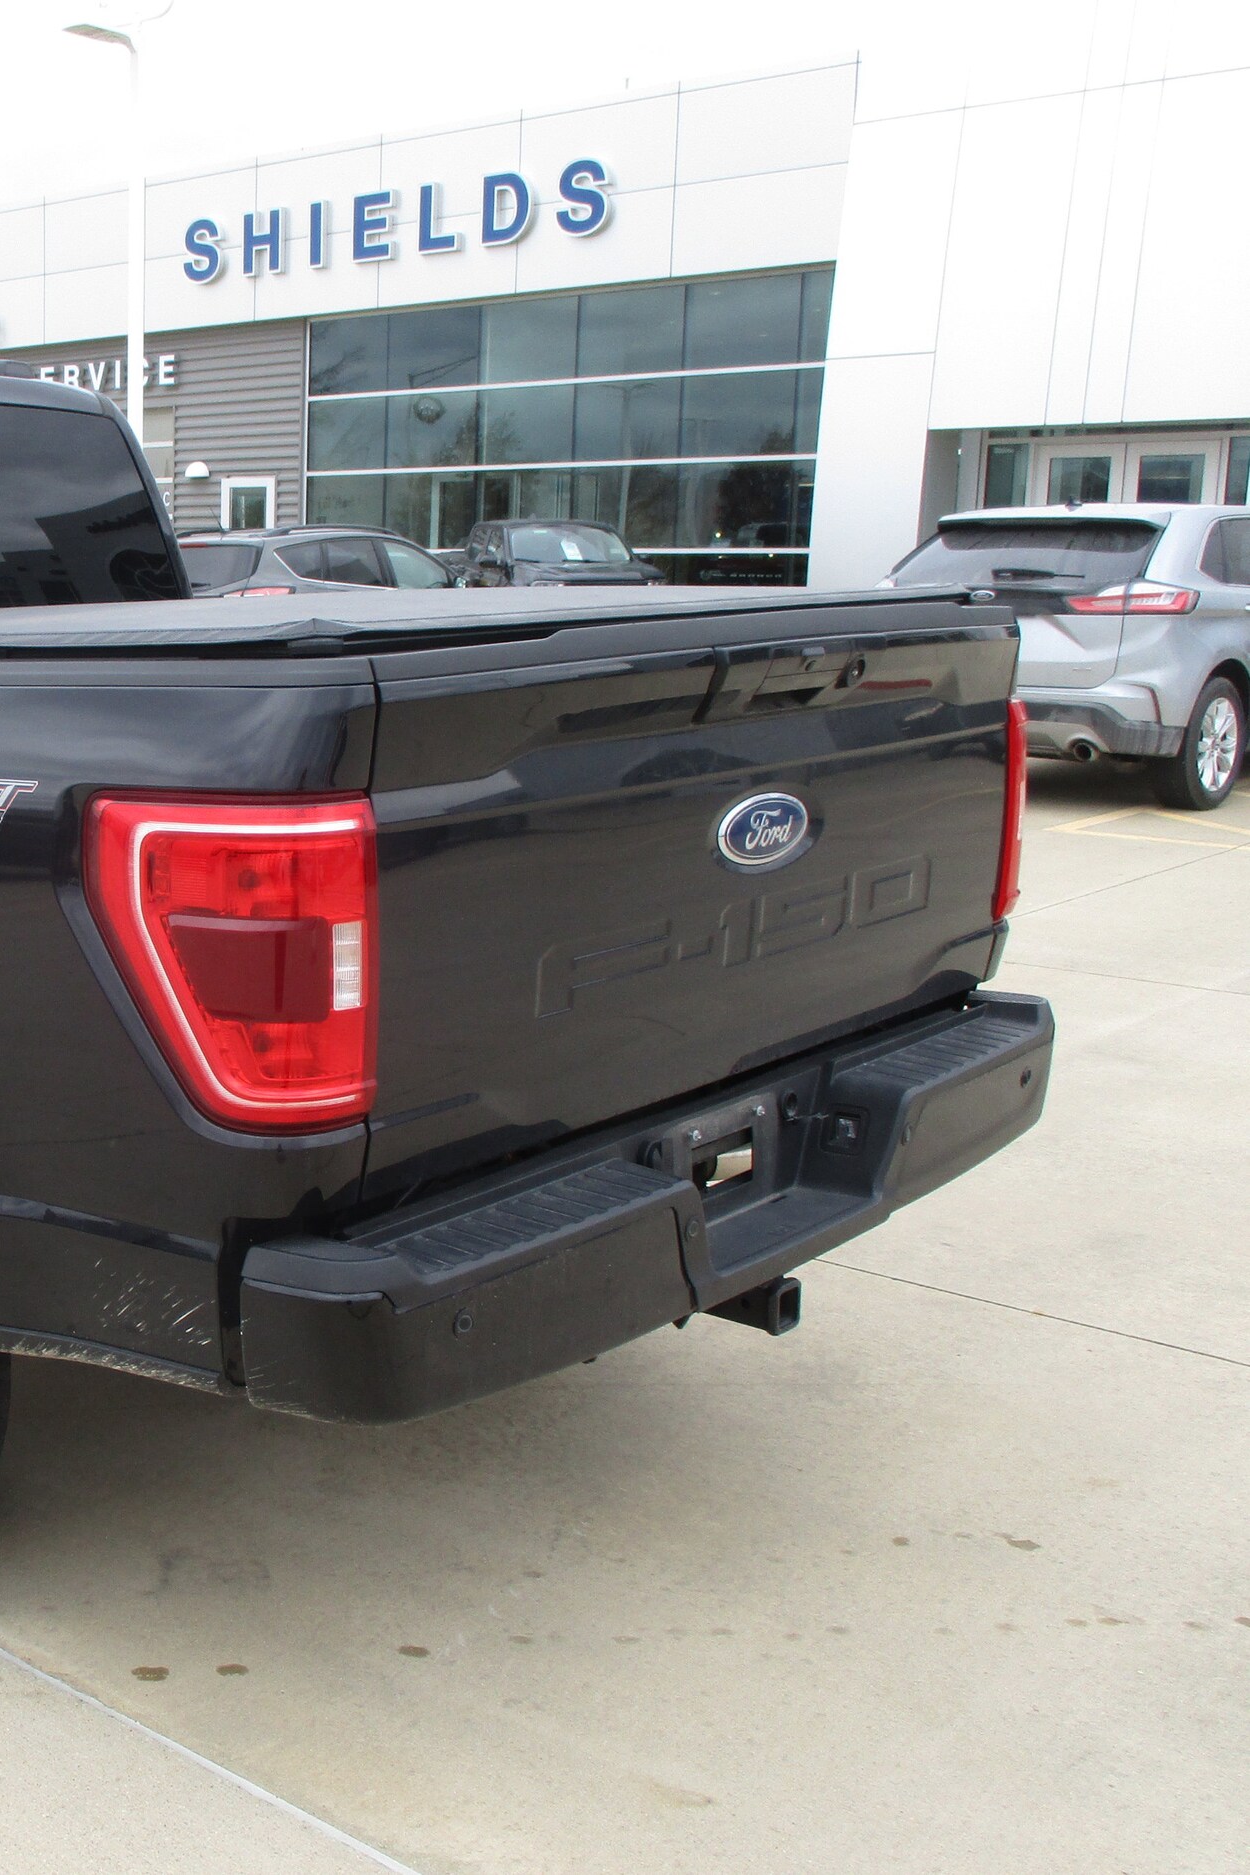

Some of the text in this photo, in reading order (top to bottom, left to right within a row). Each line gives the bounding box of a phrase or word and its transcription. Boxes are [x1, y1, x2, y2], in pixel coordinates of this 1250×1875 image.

[183, 157, 610, 285] SHIELDS
[40, 354, 175, 391] ERVIE
[745, 808, 794, 850] Ford
[535, 854, 930, 1019] F-150
